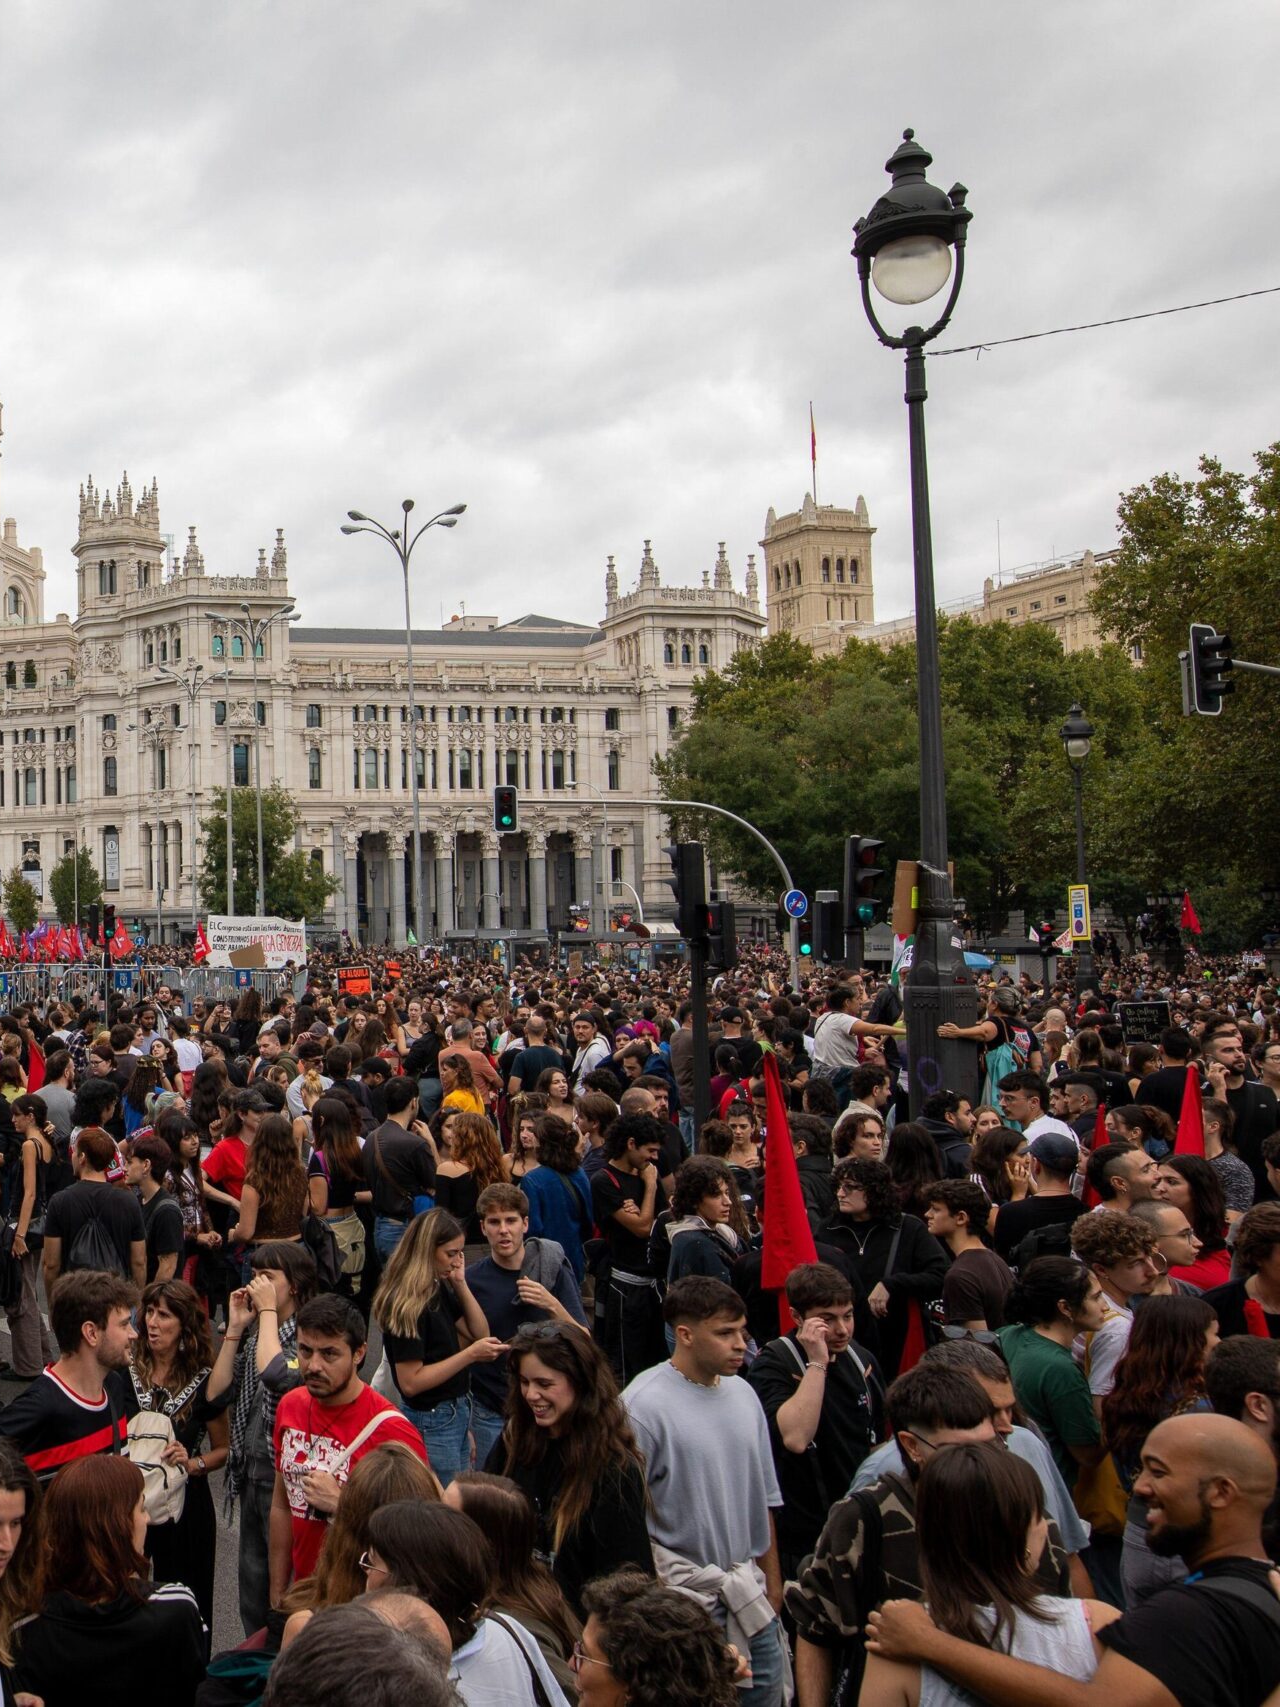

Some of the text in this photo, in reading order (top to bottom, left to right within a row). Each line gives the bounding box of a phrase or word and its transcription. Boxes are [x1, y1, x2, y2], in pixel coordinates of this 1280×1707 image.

[217, 921, 241, 933] Congreso
[339, 968, 368, 978] SE ALQUILA
